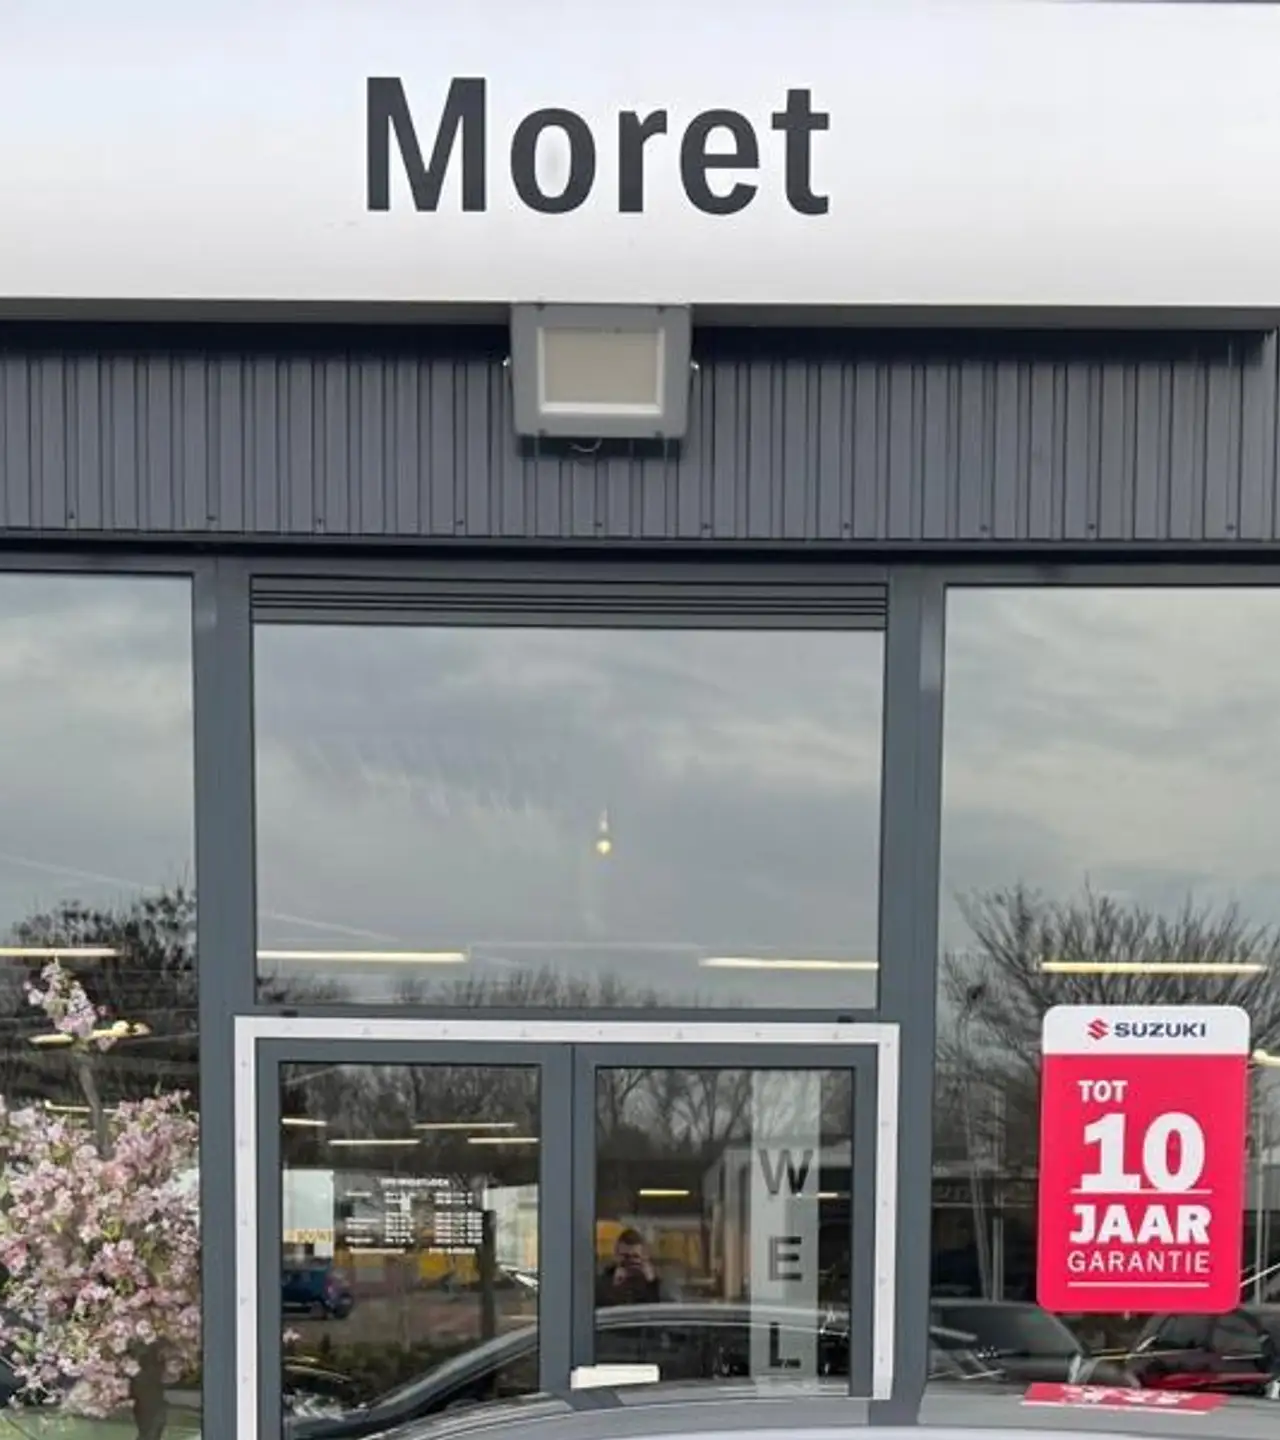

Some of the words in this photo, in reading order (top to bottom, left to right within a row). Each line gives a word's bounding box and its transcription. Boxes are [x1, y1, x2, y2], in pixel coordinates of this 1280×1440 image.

[367, 76, 830, 215] Moret
[1114, 1022, 1207, 1038] SUZUKI
[1078, 1080, 1128, 1102] TOT
[1081, 1111, 1206, 1192] 10
[1069, 1204, 1212, 1244] JAAR
[1067, 1250, 1211, 1273] GARANTIE
